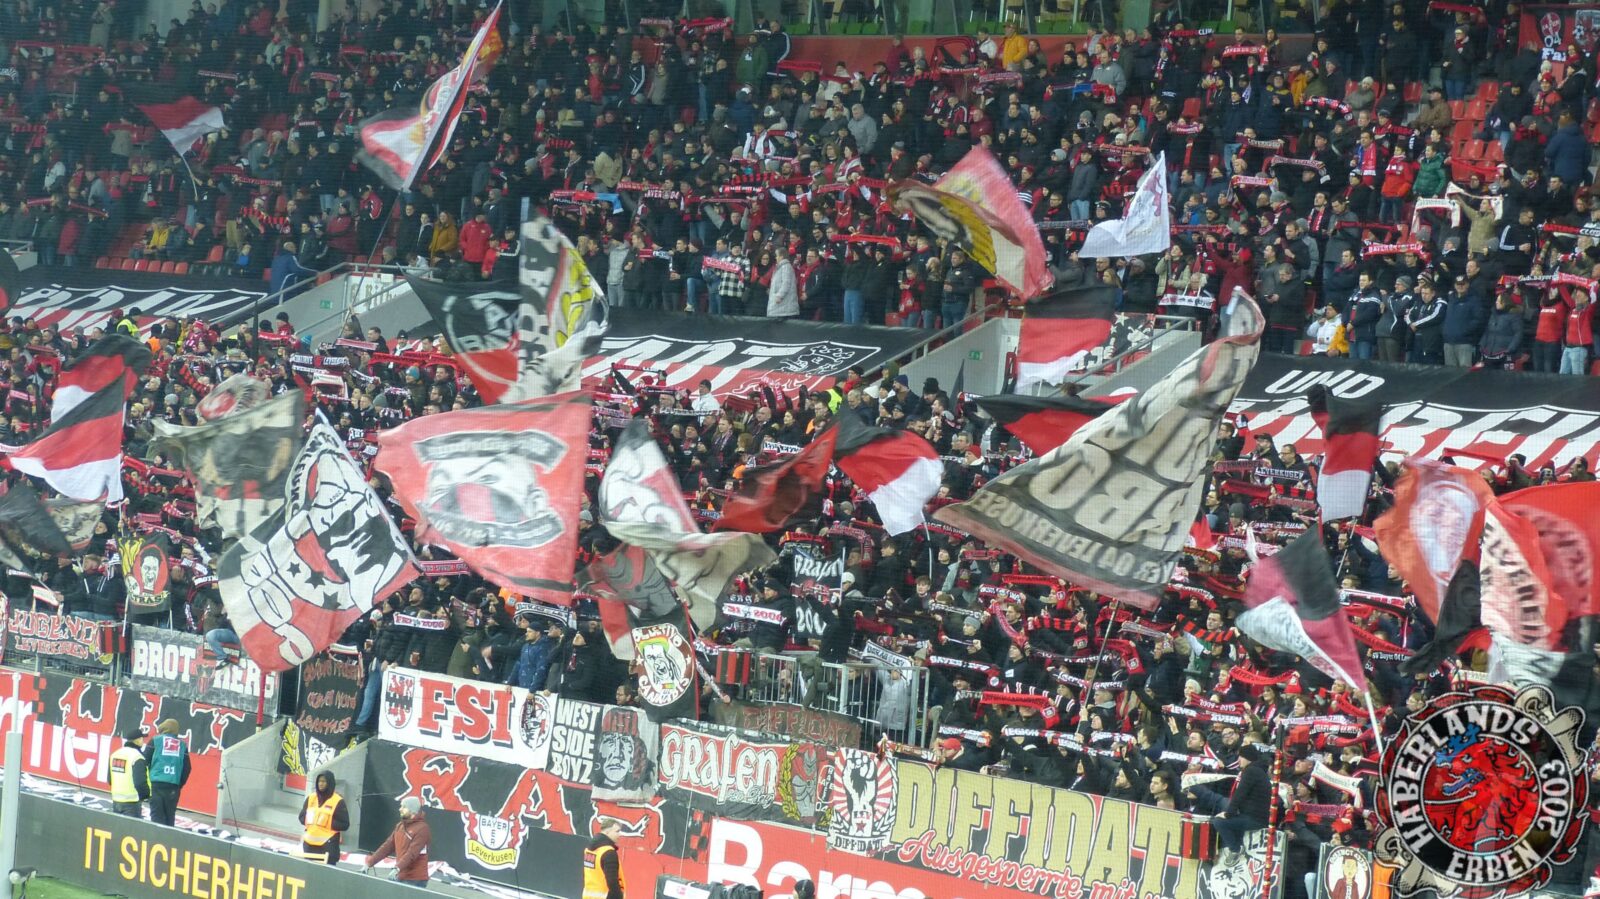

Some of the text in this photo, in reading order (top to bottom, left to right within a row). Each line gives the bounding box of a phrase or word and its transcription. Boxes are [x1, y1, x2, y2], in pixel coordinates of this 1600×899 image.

[1264, 368, 1385, 398] UND
[8, 609, 97, 644] JUGEND
[416, 676, 514, 749] FSI
[556, 698, 600, 731] WEST
[551, 725, 596, 760] SIDE
[163, 765, 175, 774] 01
[549, 751, 593, 784] BOYZ
[85, 827, 305, 899] IT SICHERHEIT
[470, 845, 513, 864] Leverkusen
